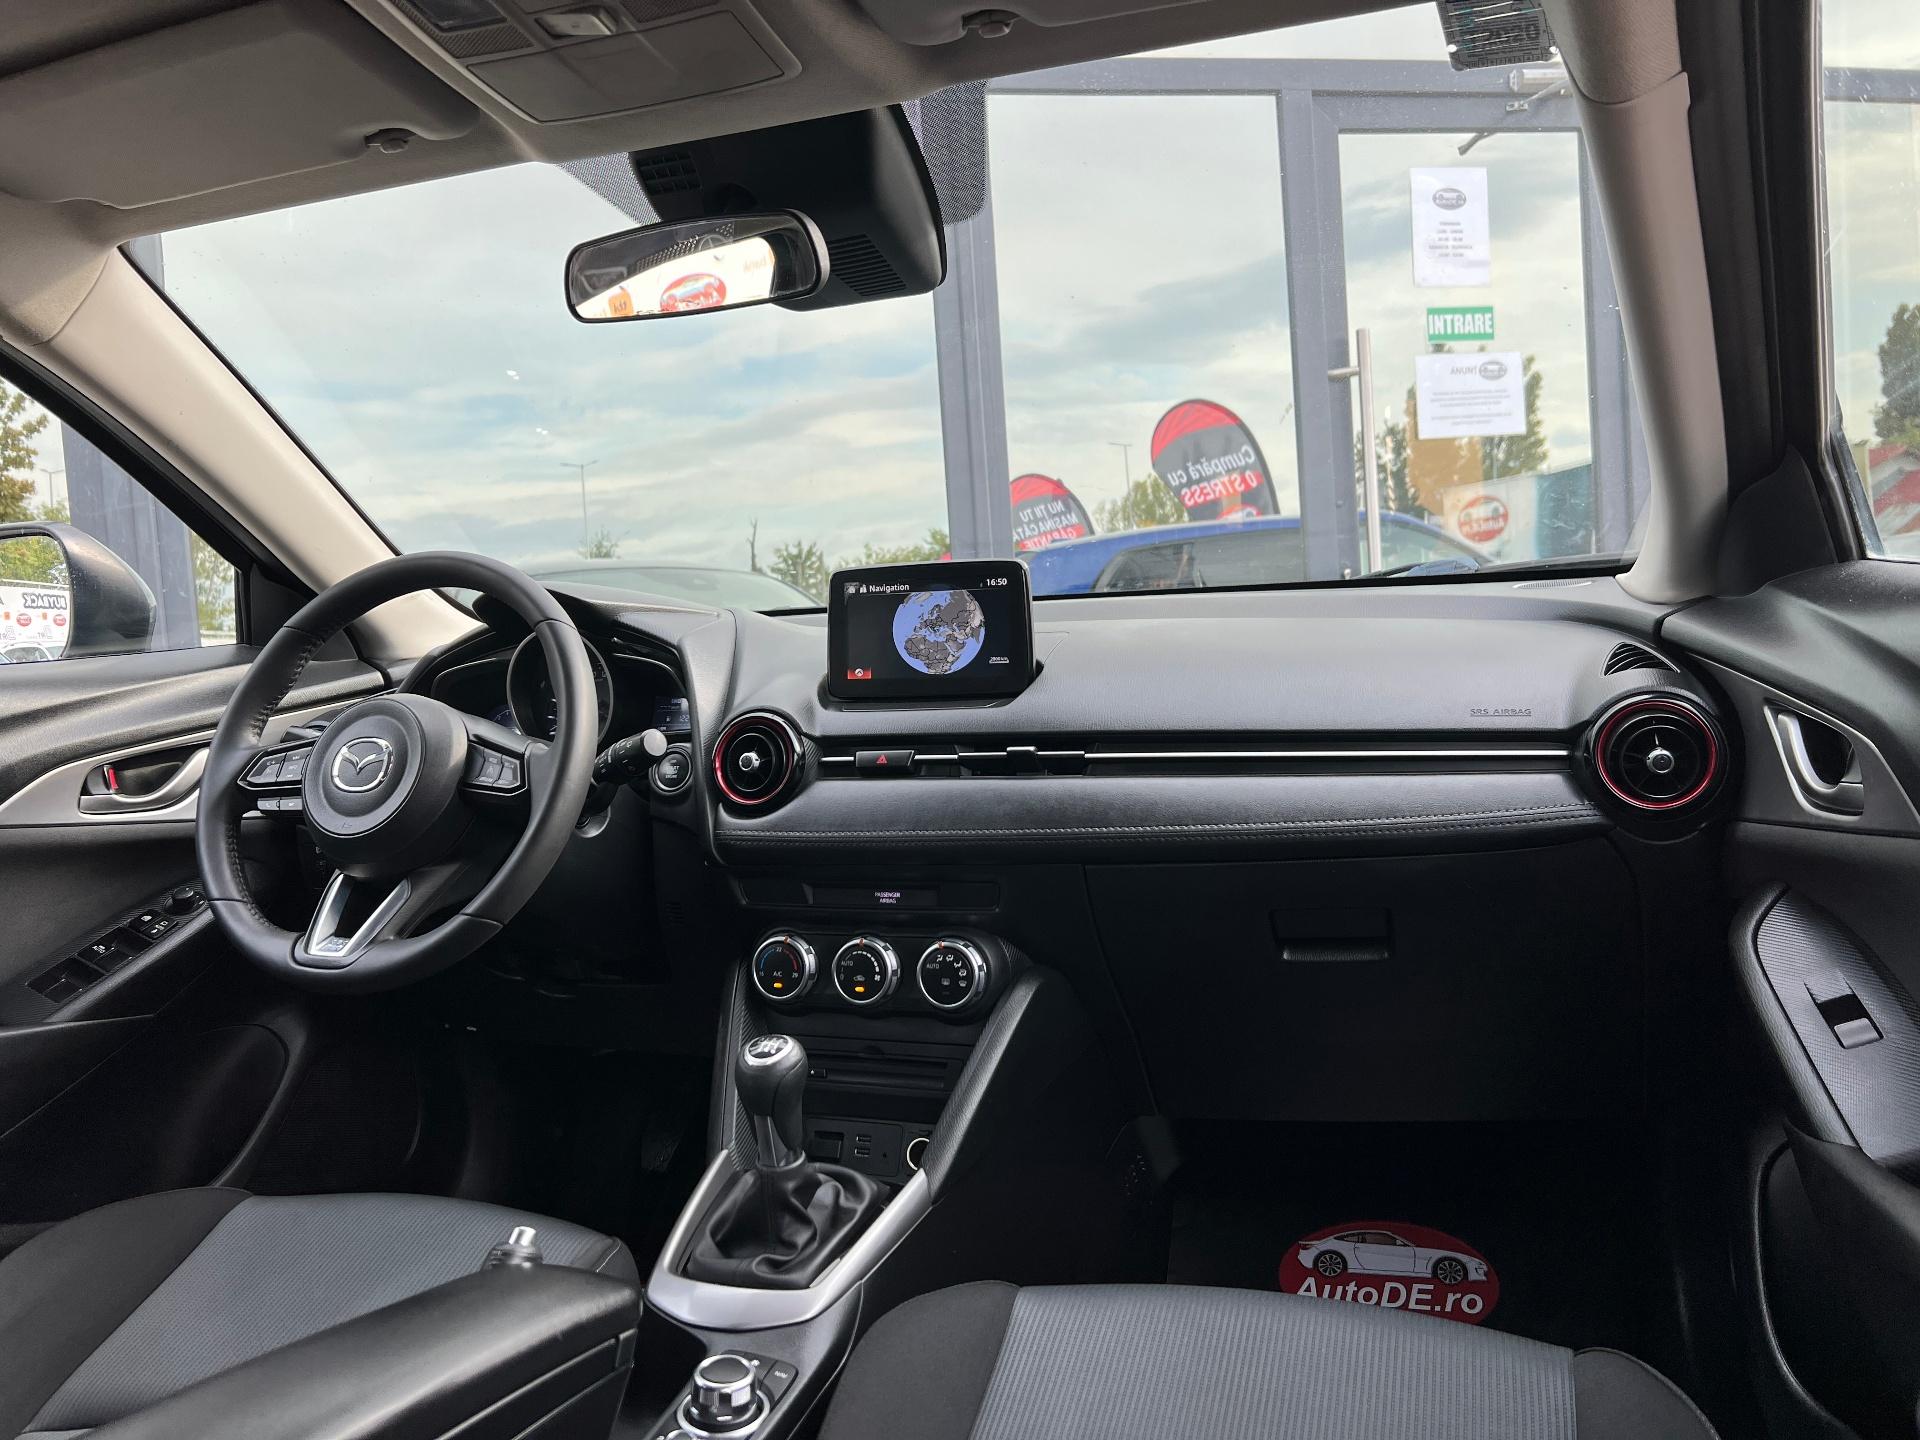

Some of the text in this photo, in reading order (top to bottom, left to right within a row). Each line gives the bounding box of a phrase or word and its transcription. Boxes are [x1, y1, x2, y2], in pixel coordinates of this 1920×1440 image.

[1428, 313, 1493, 335] INTRARE
[869, 583, 910, 593] Navigation
[986, 578, 1008, 587] 16:50
[1297, 1276, 1484, 1315] AutoDE.ro
